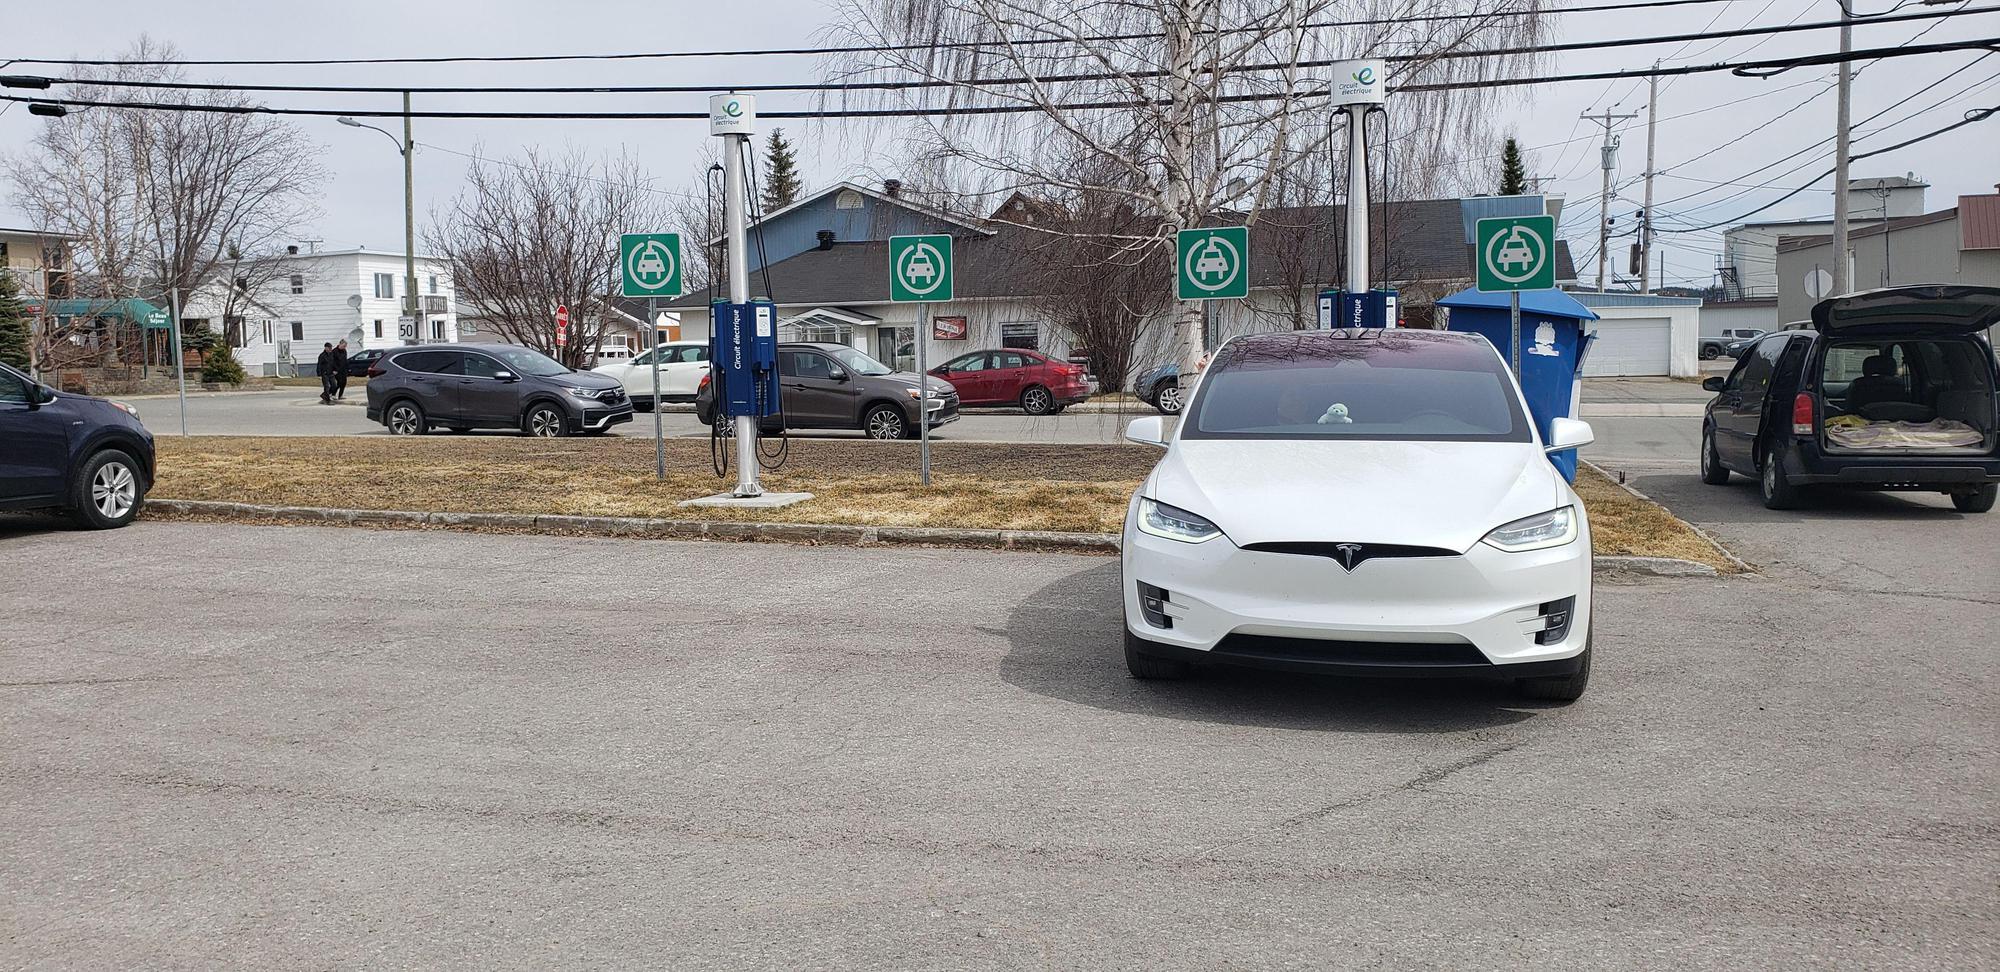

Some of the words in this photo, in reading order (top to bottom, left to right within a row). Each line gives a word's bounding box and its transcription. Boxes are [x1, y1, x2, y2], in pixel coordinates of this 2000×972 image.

[1338, 82, 1358, 90] Circuit
[1341, 87, 1372, 95] électrique
[1353, 299, 1363, 328] ctrique
[400, 324, 413, 337] 50
[732, 309, 741, 344] électrique
